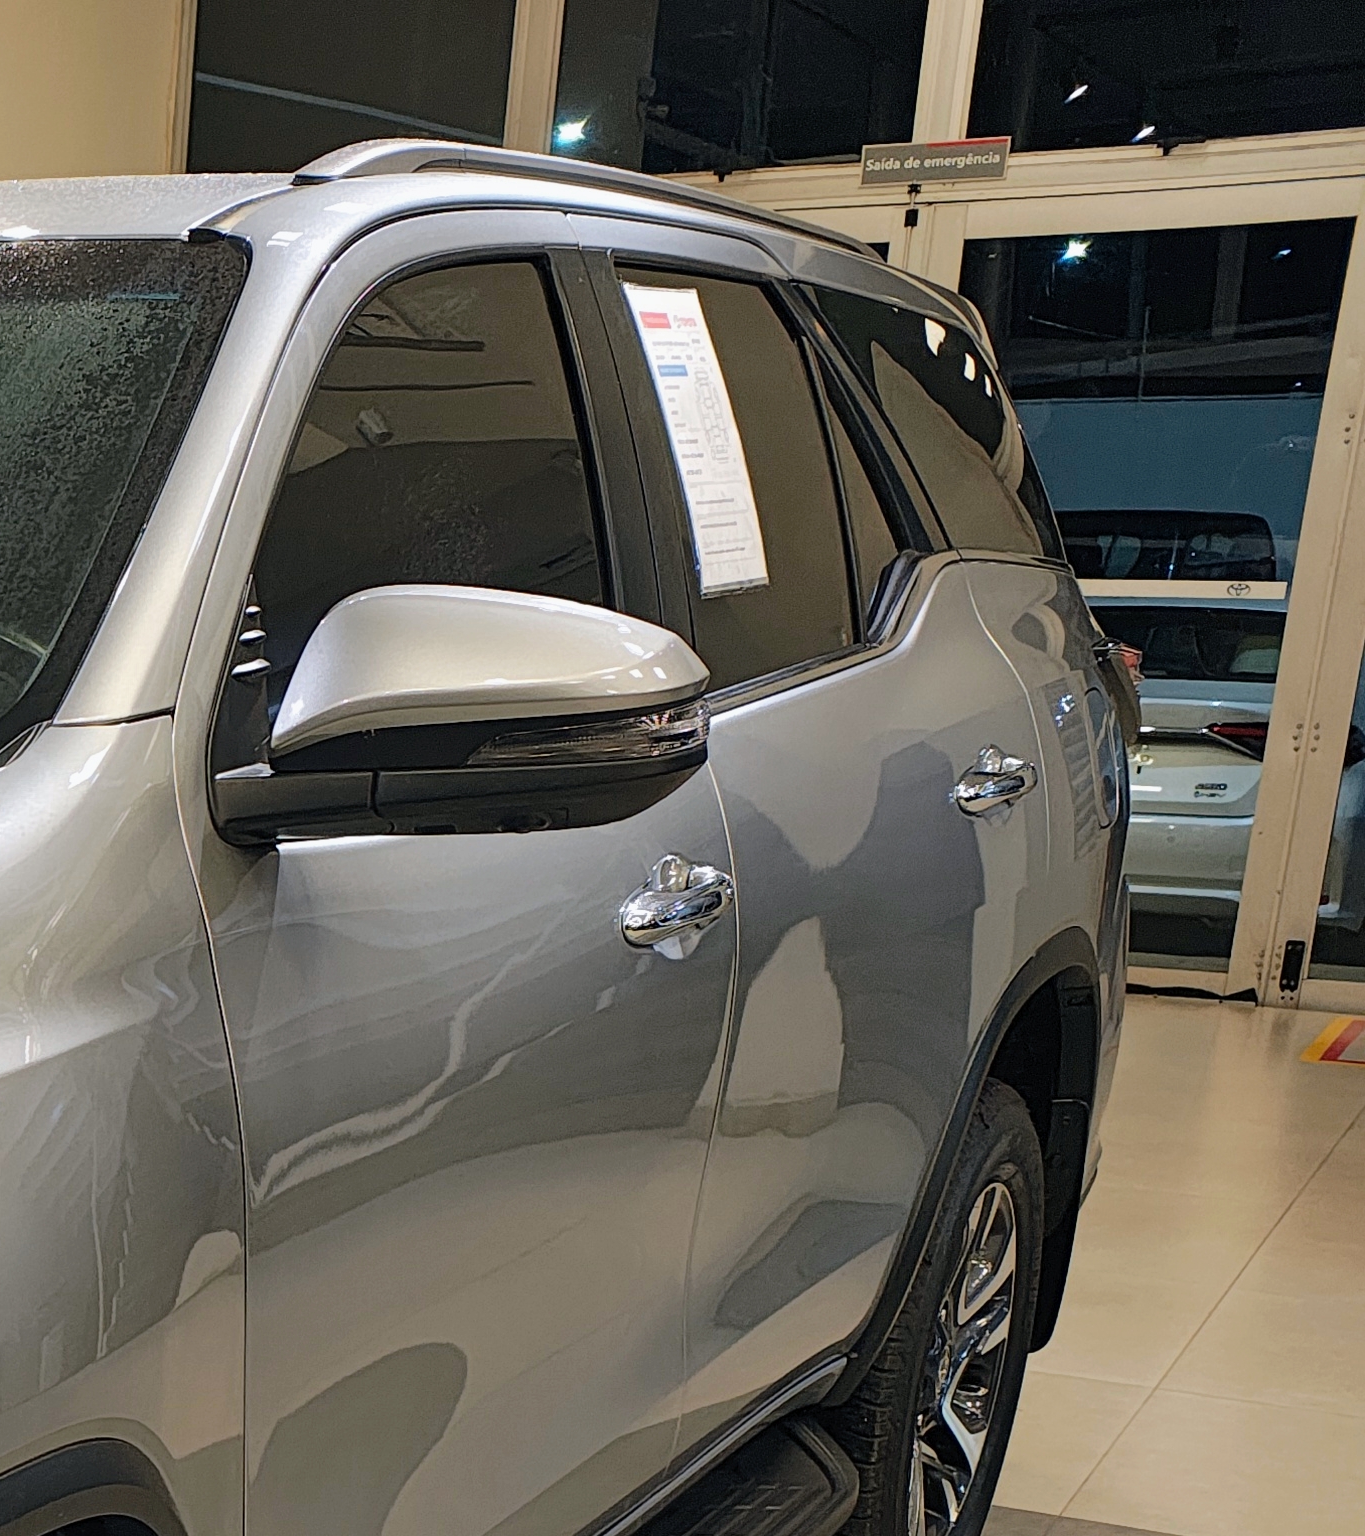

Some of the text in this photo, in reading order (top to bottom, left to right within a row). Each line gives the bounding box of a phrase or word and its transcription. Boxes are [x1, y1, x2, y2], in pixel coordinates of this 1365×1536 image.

[865, 152, 1001, 171] Saída de emergência
